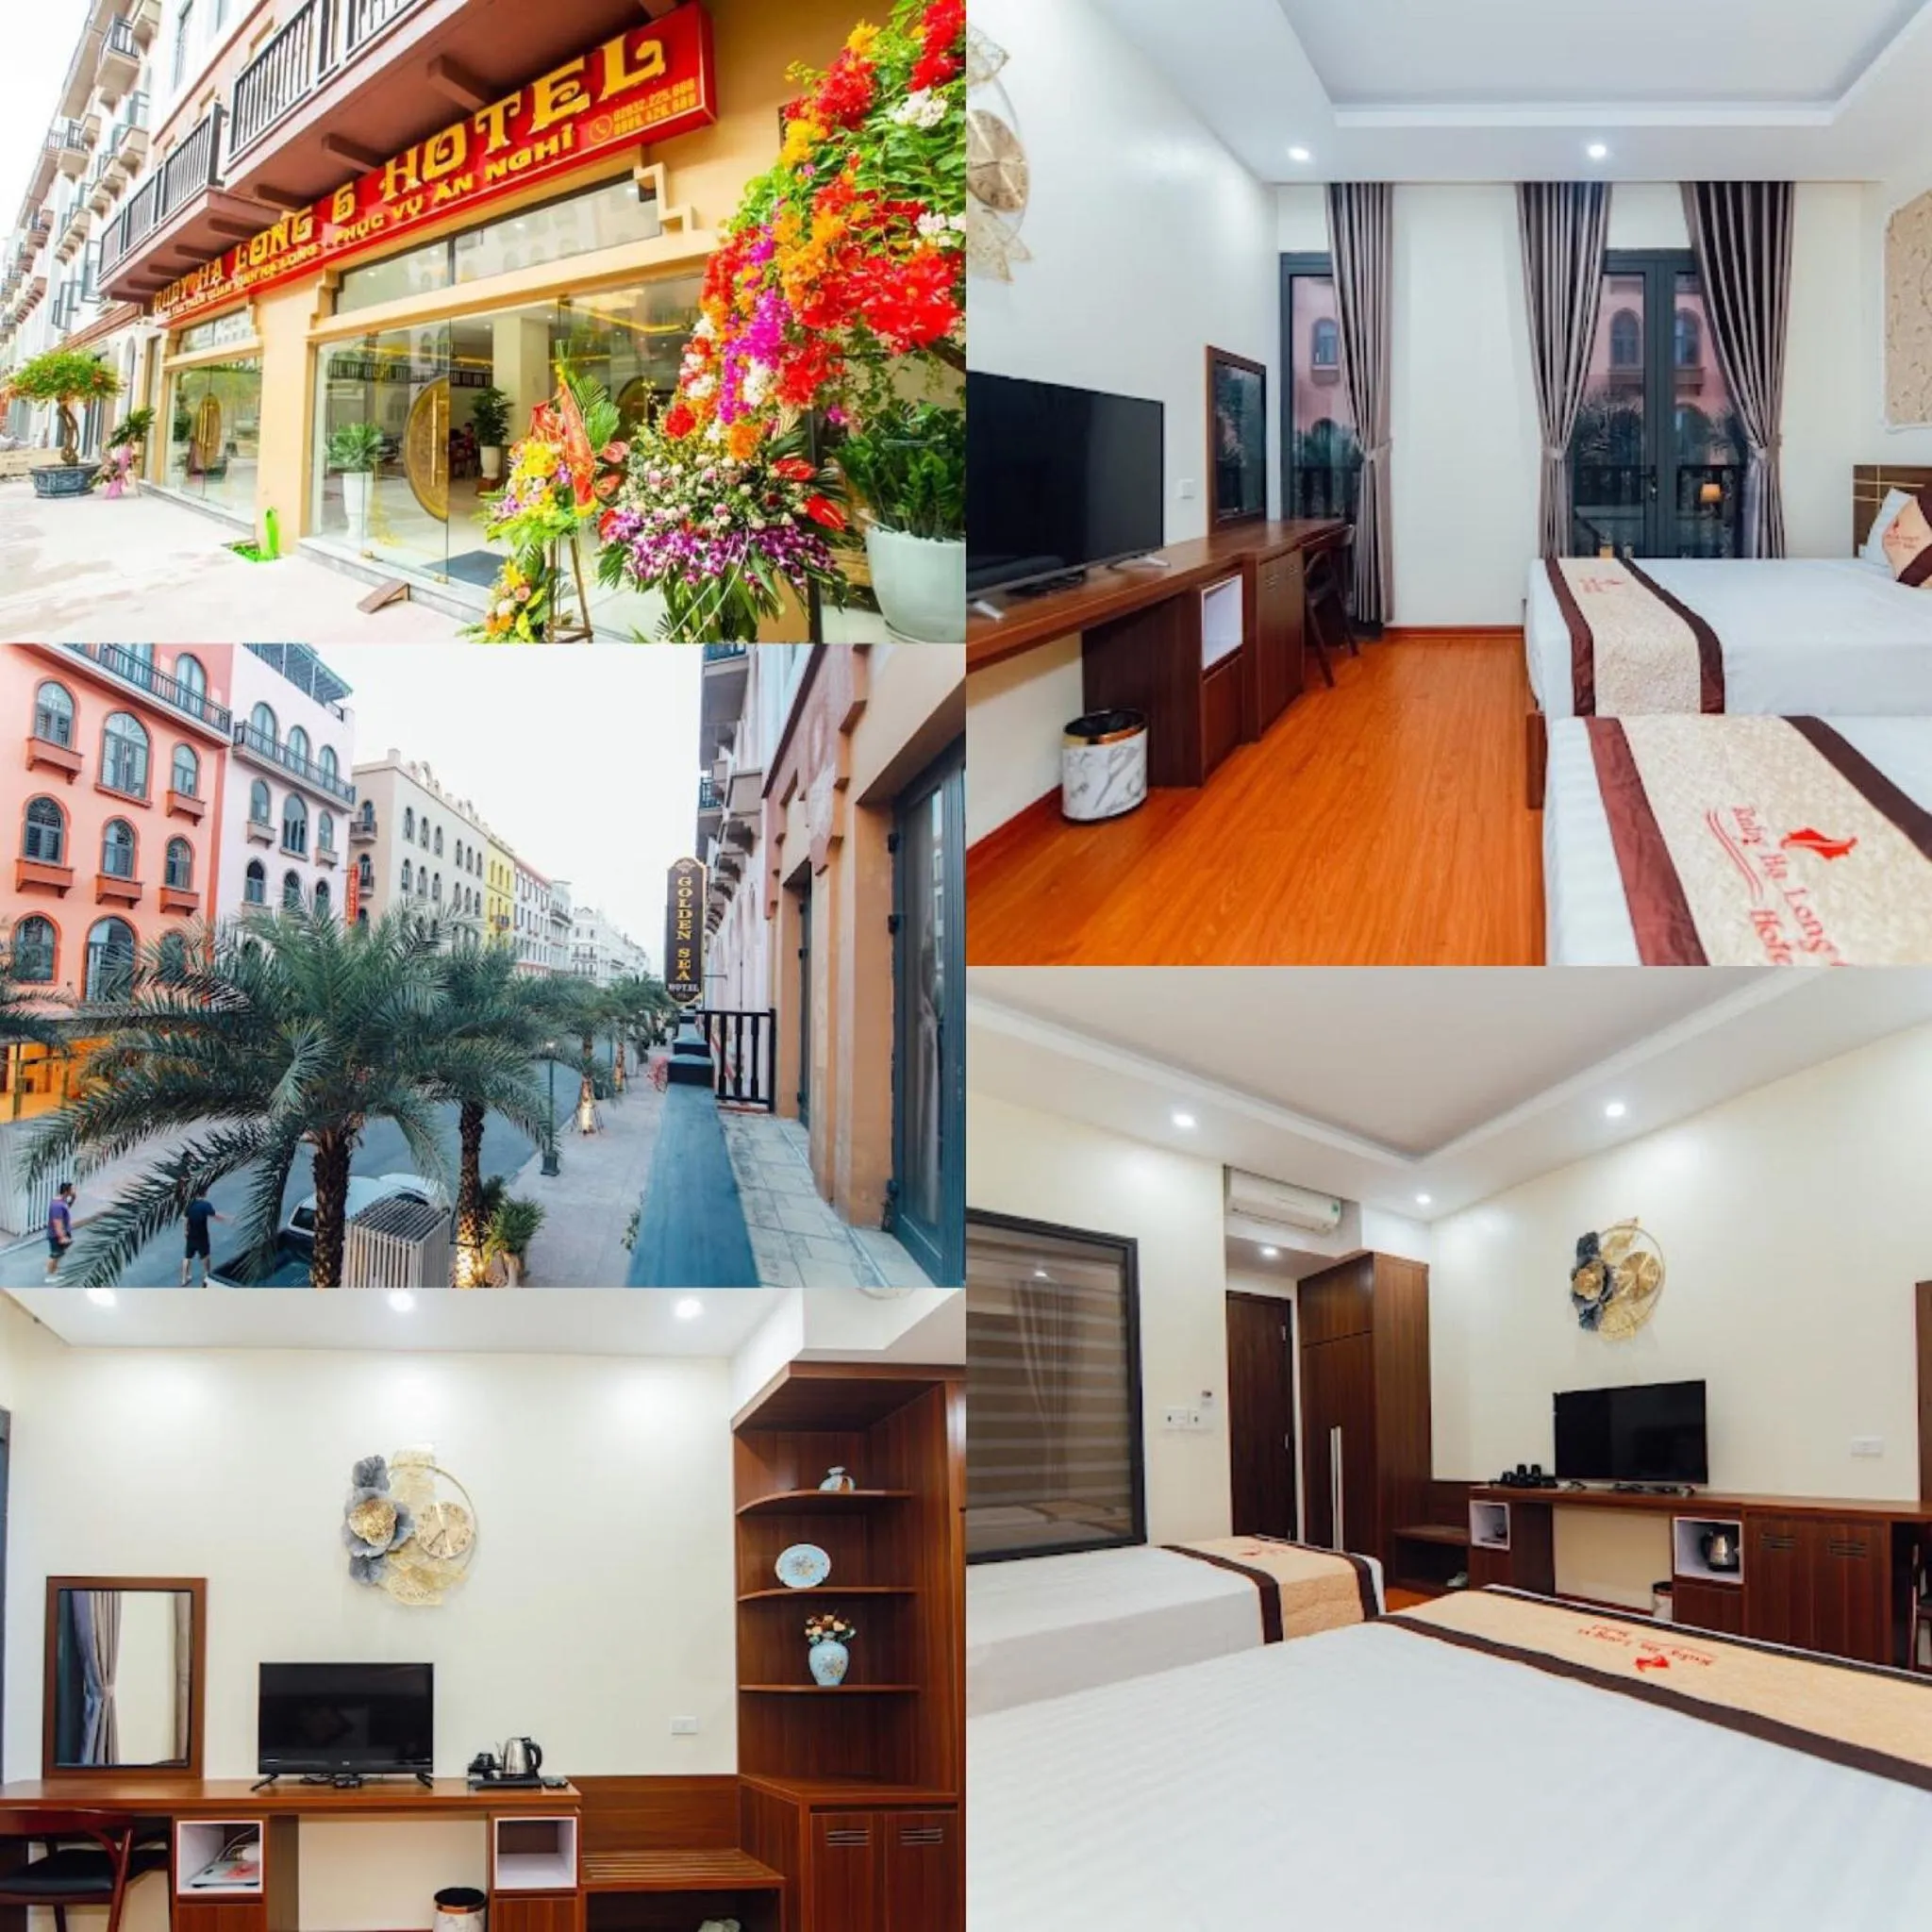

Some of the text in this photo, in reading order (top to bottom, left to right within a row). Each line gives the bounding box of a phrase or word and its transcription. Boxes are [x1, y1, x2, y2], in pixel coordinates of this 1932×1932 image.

[235, 206, 314, 272] LONG
[380, 33, 666, 203] HOTEL
[391, 194, 424, 223] VỤ
[675, 875, 694, 941] GOLDEN
[675, 947, 692, 981] SEA
